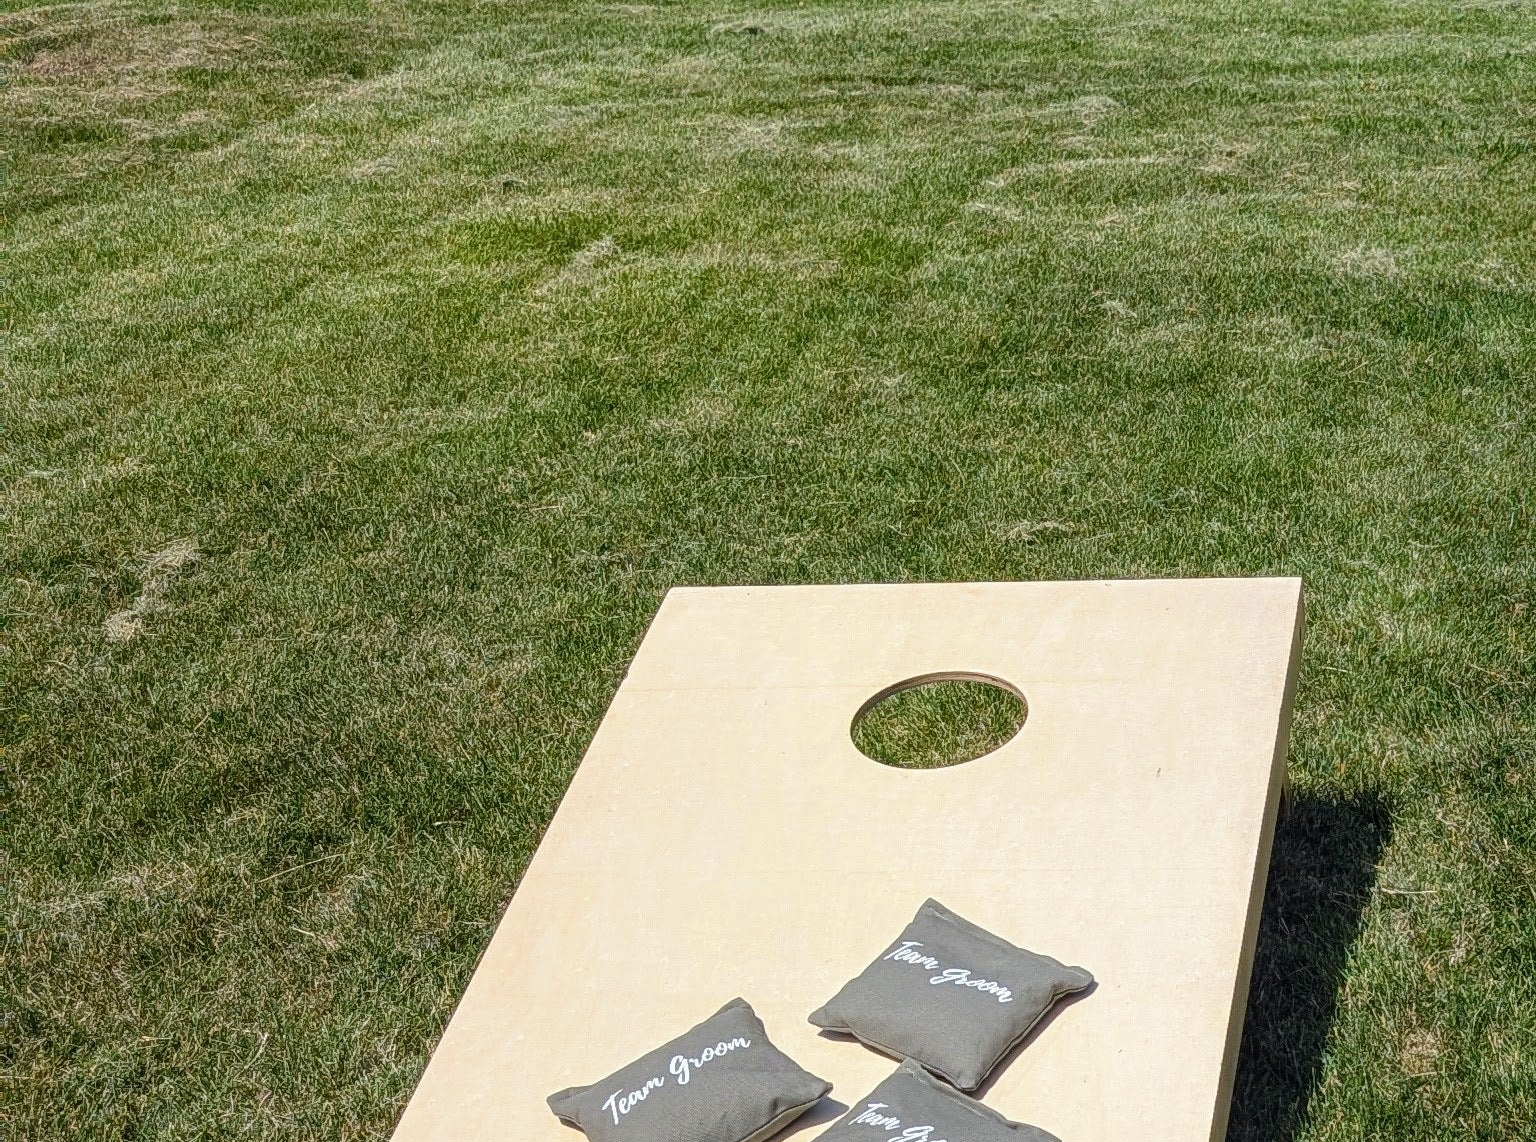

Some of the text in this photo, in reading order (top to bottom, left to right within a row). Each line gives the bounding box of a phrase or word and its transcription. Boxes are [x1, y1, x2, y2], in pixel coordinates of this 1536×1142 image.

[883, 941, 1013, 1003] Team Groom
[601, 1036, 752, 1126] Team Groom
[847, 1102, 900, 1131] Team
